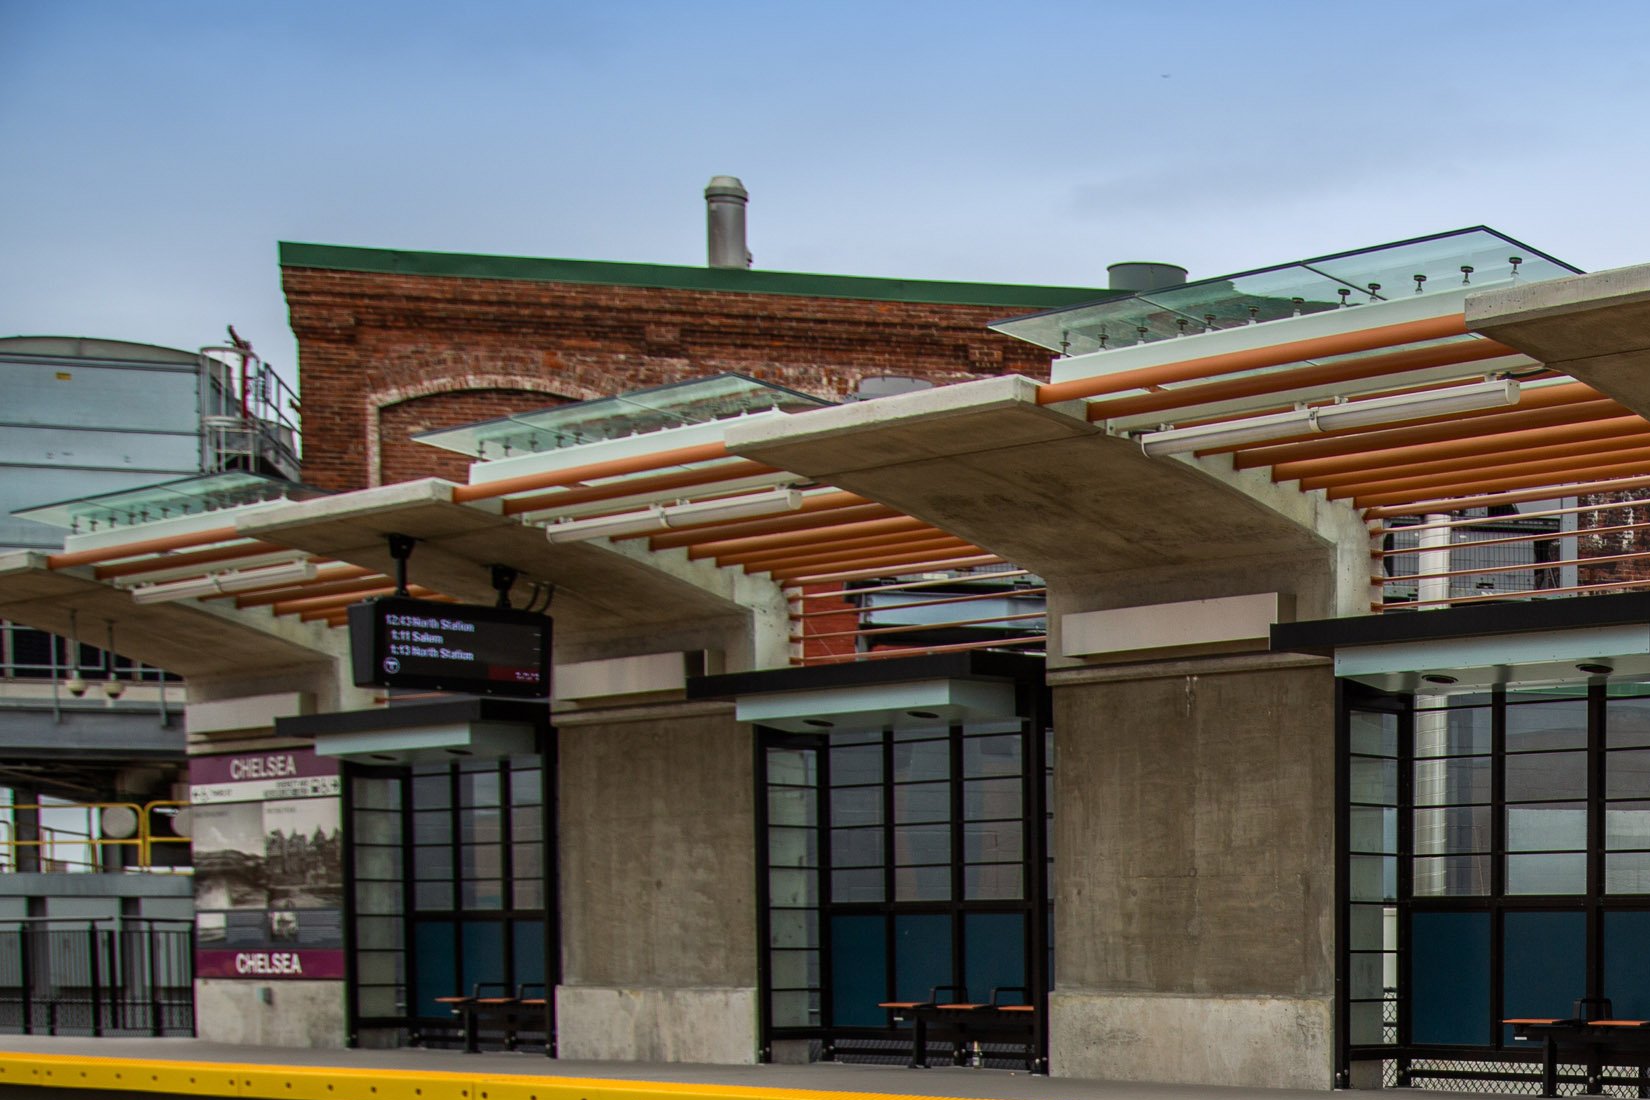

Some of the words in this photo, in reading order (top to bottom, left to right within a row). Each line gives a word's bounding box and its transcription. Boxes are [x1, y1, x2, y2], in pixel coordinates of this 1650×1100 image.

[412, 616, 439, 629] North
[440, 618, 475, 632] Station
[412, 631, 444, 644] Salem
[411, 645, 439, 658] North
[440, 648, 475, 660] Station
[230, 755, 297, 780] CHELSEA
[235, 952, 302, 974] CHELSEA
